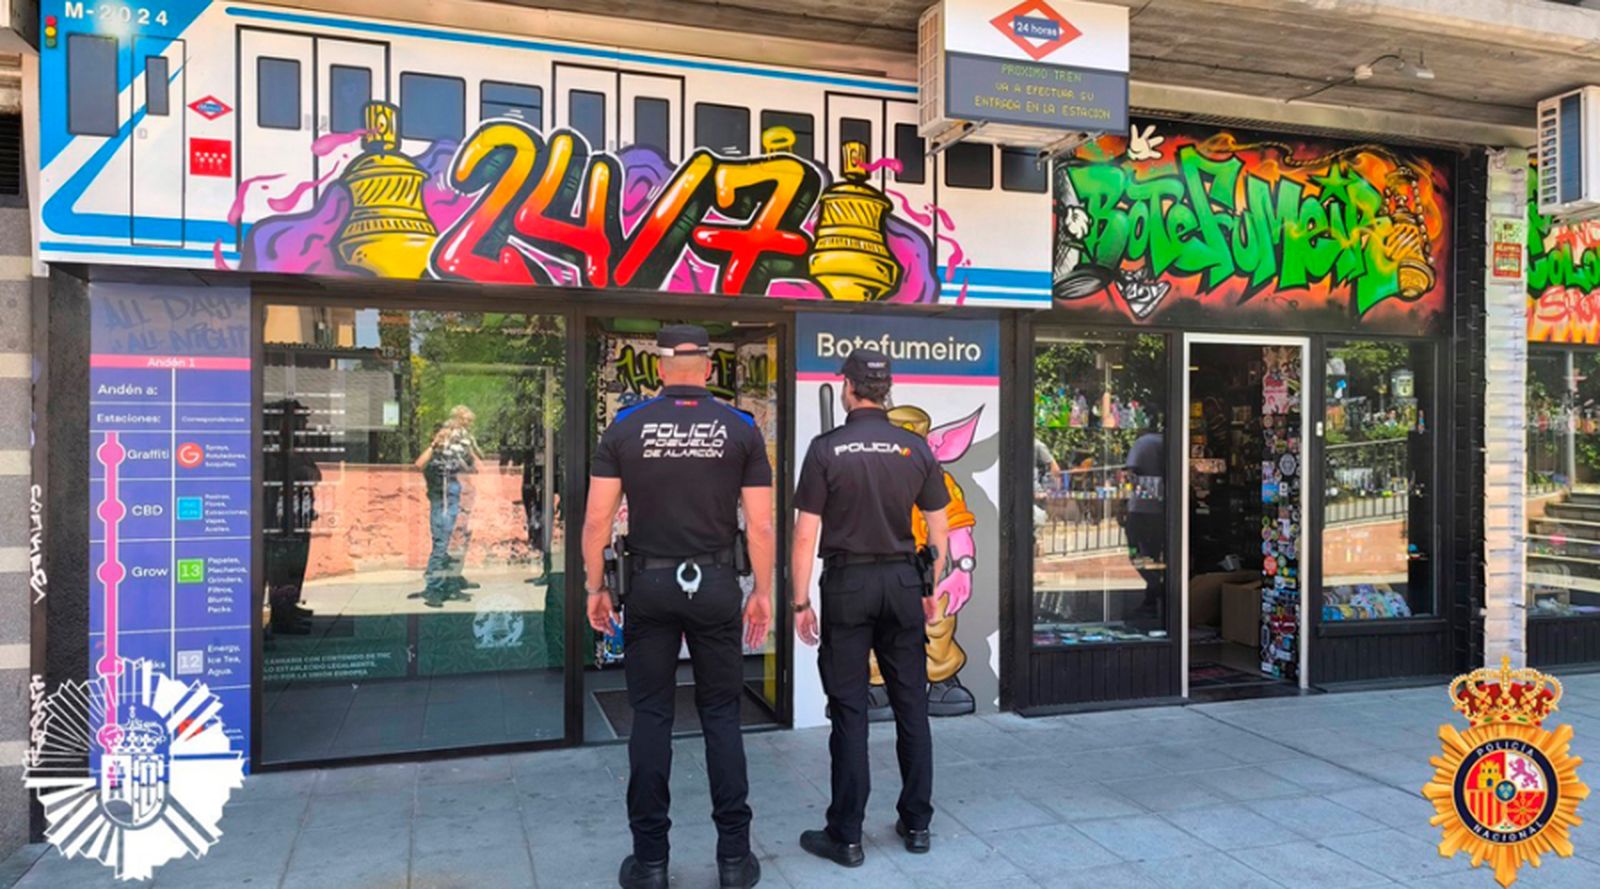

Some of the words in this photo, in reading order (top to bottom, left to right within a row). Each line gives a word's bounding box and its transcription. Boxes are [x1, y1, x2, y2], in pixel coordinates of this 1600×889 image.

[1016, 21, 1030, 33] 24
[1030, 23, 1057, 37] horas
[1054, 69, 1082, 83] TREN
[974, 95, 1021, 112] ENTRADA
[1025, 100, 1040, 113] EN
[1043, 103, 1056, 115] LA
[1062, 104, 1111, 120] ESTACION
[816, 331, 982, 362] Botefumeiro
[147, 357, 186, 368] Andén
[189, 357, 196, 368] 1
[97, 383, 143, 396] Andén
[145, 385, 158, 396] a:
[96, 413, 161, 425] Estaciones:
[640, 418, 729, 440] POLICÍA
[127, 448, 170, 461] Graffiti
[180, 445, 200, 464] G
[642, 449, 661, 459] DE
[662, 447, 725, 459] ALARCÓN
[834, 442, 902, 457] POLICIA
[132, 504, 163, 516] CBD
[131, 566, 168, 578] Grow
[181, 564, 201, 578] 13
[181, 655, 201, 669] 12
